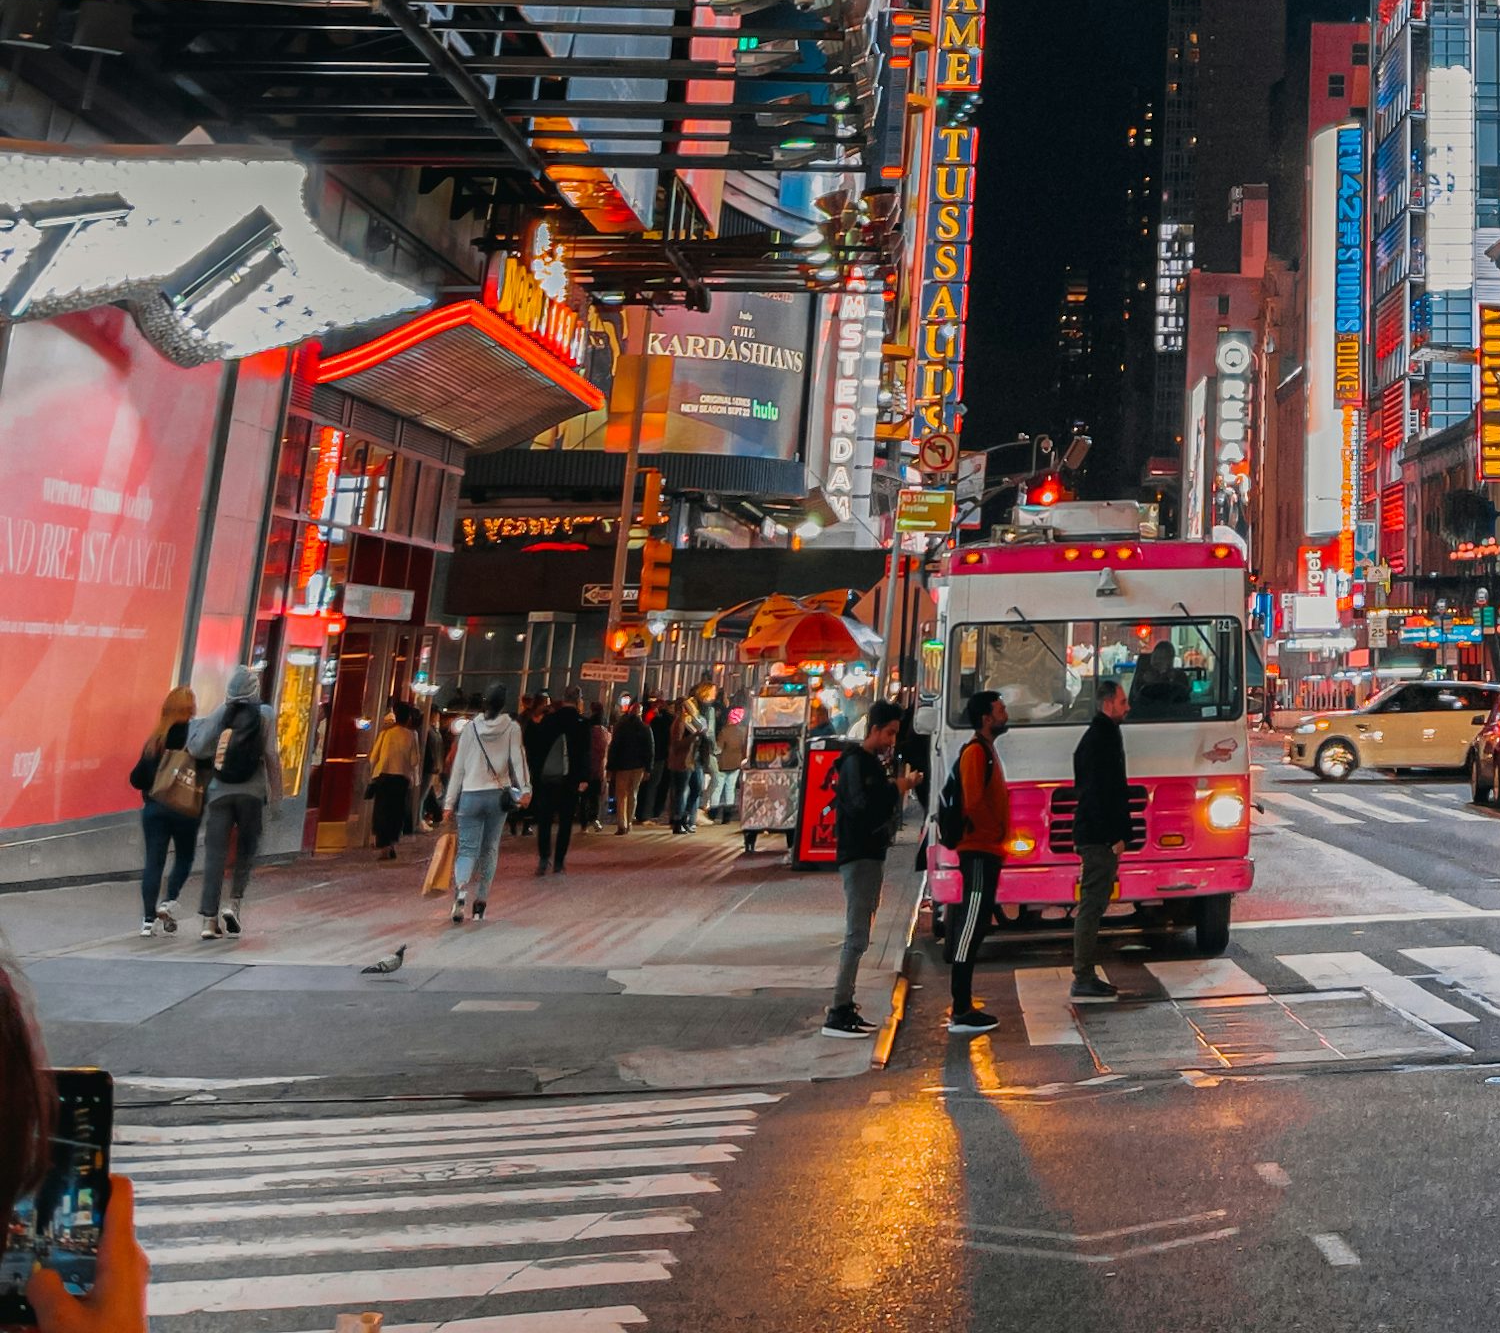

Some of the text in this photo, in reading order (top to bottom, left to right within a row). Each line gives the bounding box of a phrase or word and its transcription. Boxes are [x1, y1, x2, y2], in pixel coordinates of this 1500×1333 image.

[1338, 129, 1361, 173] NEW
[1336, 247, 1362, 332] STUDIOS
[731, 325, 756, 339] THE
[647, 333, 804, 373] KARDASHIANS
[1336, 341, 1360, 391] DUKE
[752, 399, 779, 421] hulu
[0, 514, 177, 591] ND BREAST CANCER
[1217, 619, 1231, 631] 24
[1370, 628, 1385, 638] 25
